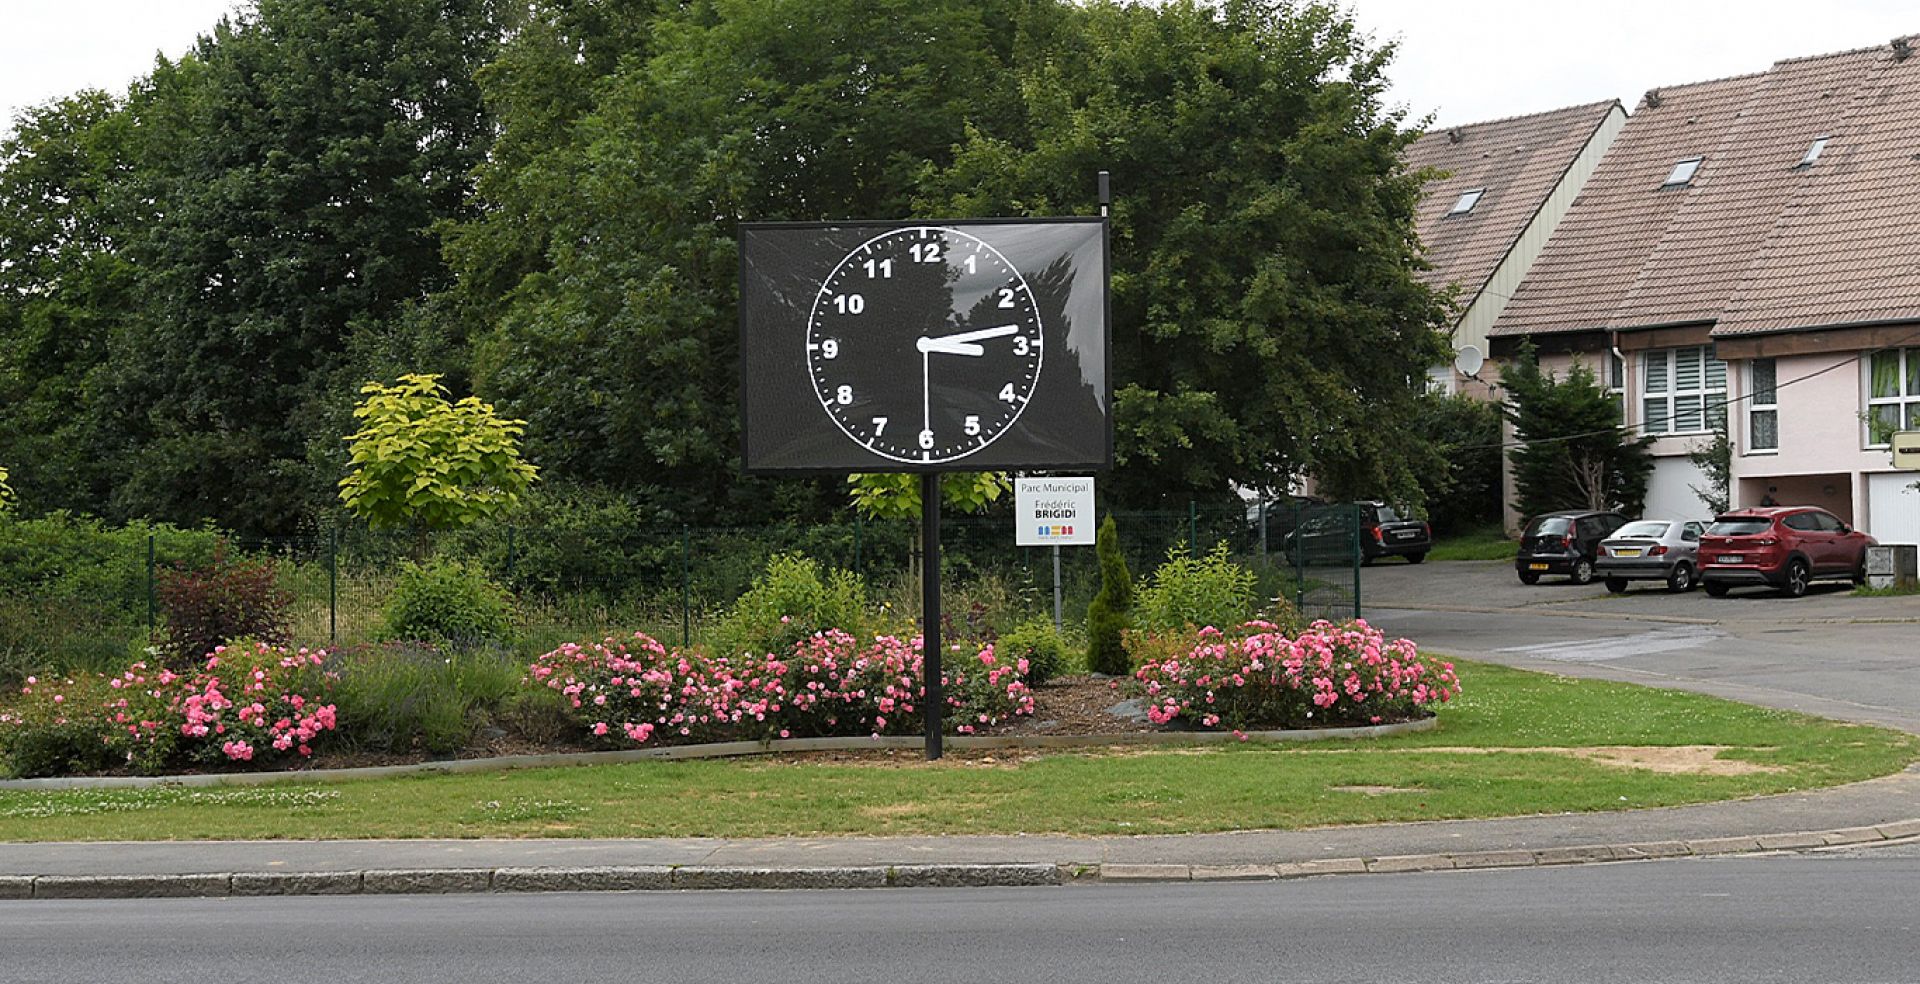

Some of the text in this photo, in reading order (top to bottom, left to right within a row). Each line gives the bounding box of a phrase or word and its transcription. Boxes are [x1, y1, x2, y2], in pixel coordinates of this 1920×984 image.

[909, 243, 941, 263] 12
[863, 258, 892, 278] 11
[963, 254, 977, 274] 1
[834, 294, 864, 314] 10
[998, 288, 1015, 308] 2
[822, 339, 839, 359] 9
[1013, 336, 1029, 356] 3
[837, 385, 853, 405] 8
[999, 382, 1016, 403] 4
[872, 417, 888, 436] 7
[964, 415, 981, 435] 5
[918, 429, 934, 450] 6
[1021, 482, 1089, 494] Parc Municipal
[1035, 499, 1076, 509] Frédéric
[1035, 510, 1076, 519] BRIGIDI
